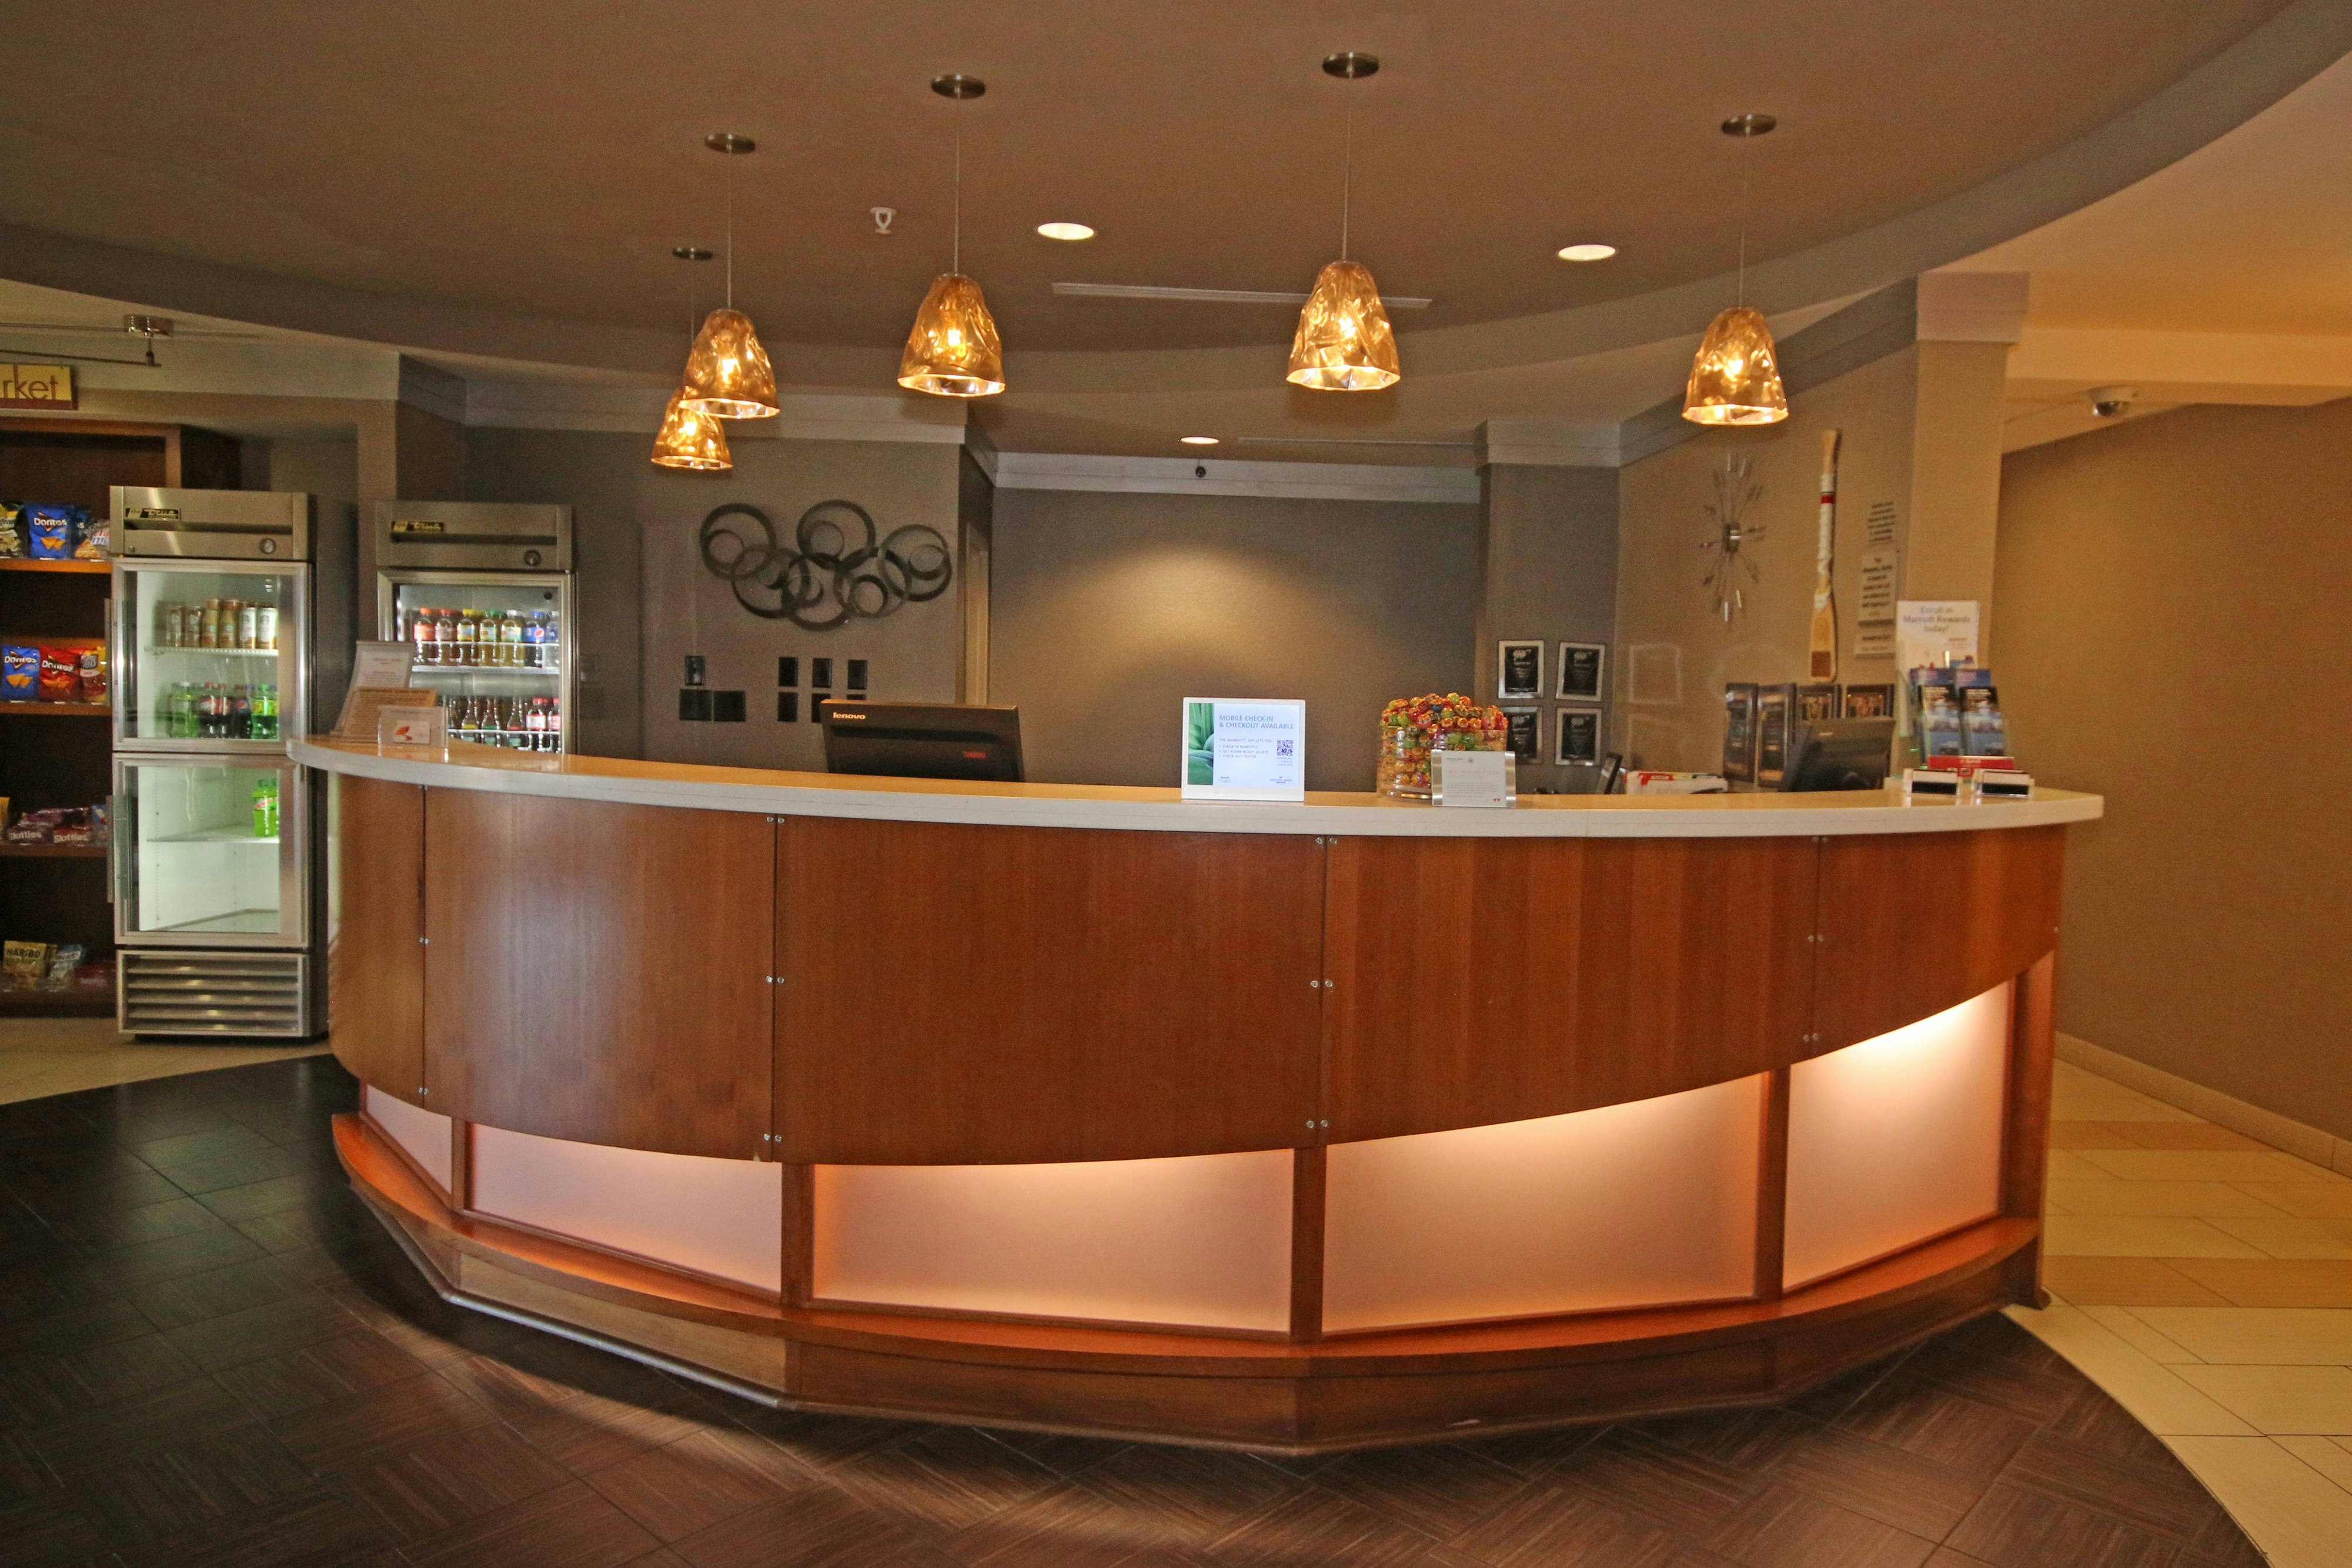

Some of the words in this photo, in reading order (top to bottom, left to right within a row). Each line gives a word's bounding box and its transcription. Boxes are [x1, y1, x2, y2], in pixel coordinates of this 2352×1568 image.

[34, 517, 67, 526] Doritos
[42, 660, 74, 672] Doritos
[6, 948, 41, 958] HARIBO
